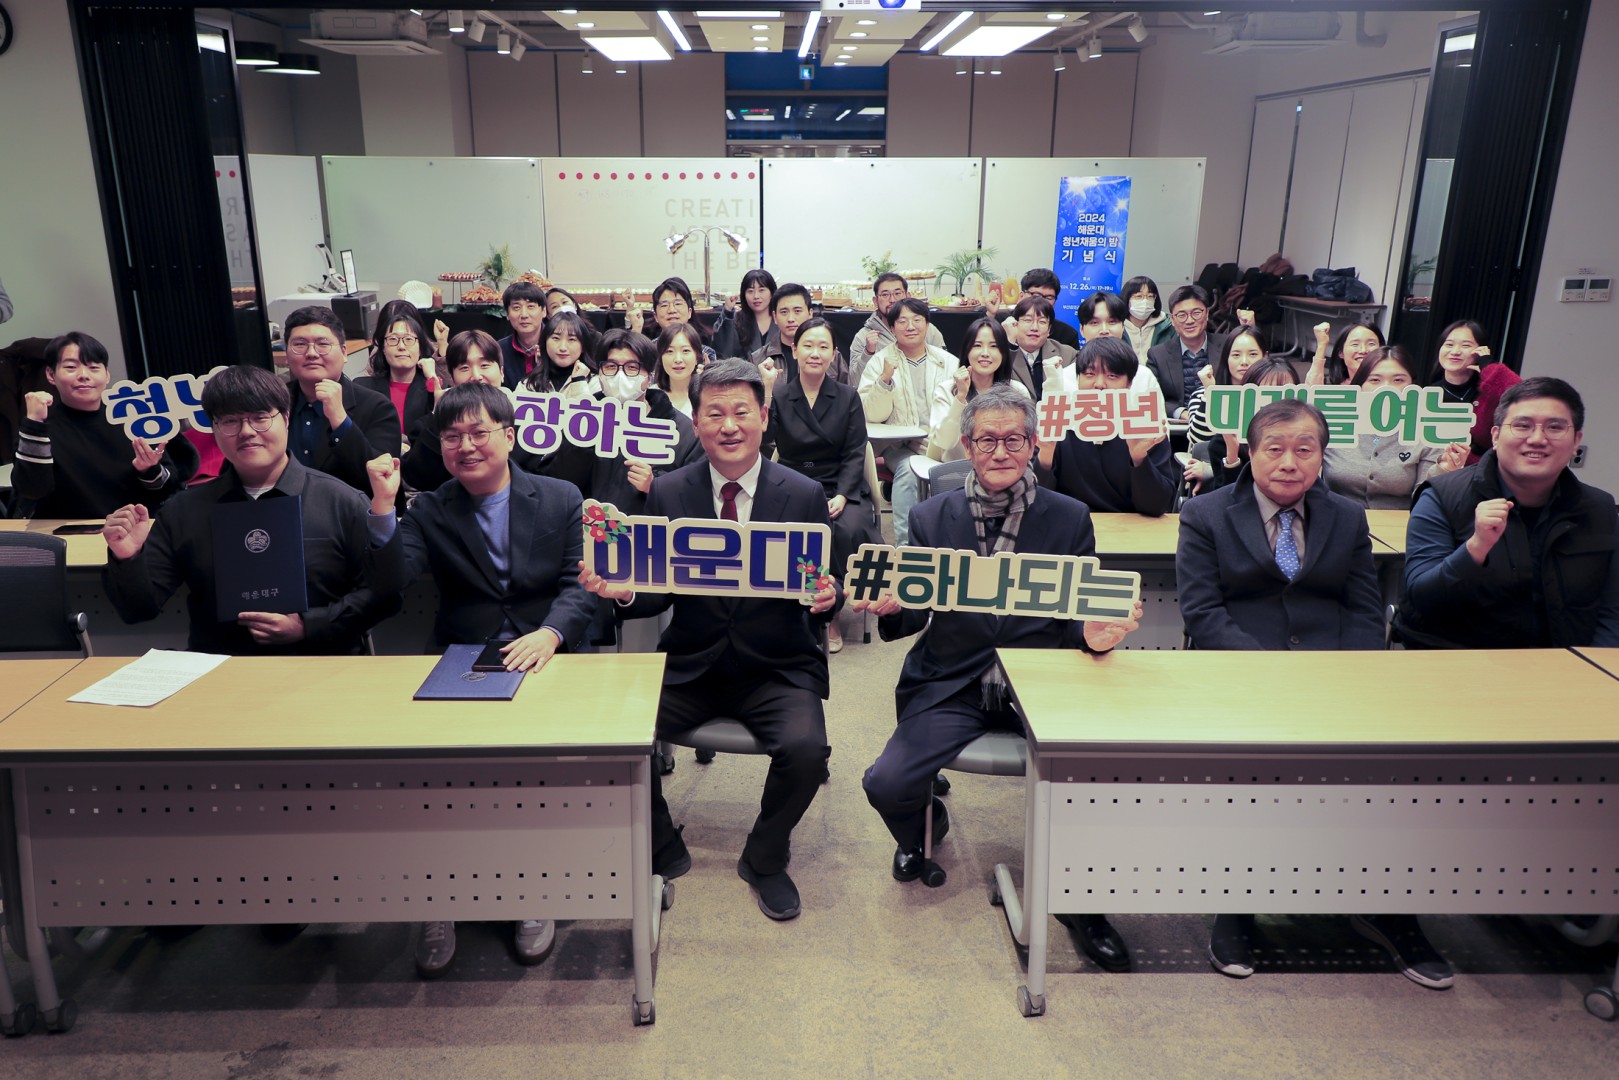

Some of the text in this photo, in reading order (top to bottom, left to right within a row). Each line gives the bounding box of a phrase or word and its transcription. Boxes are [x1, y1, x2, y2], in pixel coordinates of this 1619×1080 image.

[664, 198, 754, 218] CREATI
[1078, 213, 1106, 223] 2024
[1062, 236, 1119, 248] 청년채움의 밤
[1077, 225, 1105, 235] 해운대
[726, 251, 758, 270] BE
[513, 395, 674, 459] 장하는
[1039, 391, 1160, 438] #청년
[1209, 388, 1472, 444] 미를 여는
[593, 519, 823, 593] 해운대
[849, 549, 1135, 619] #하나되는
